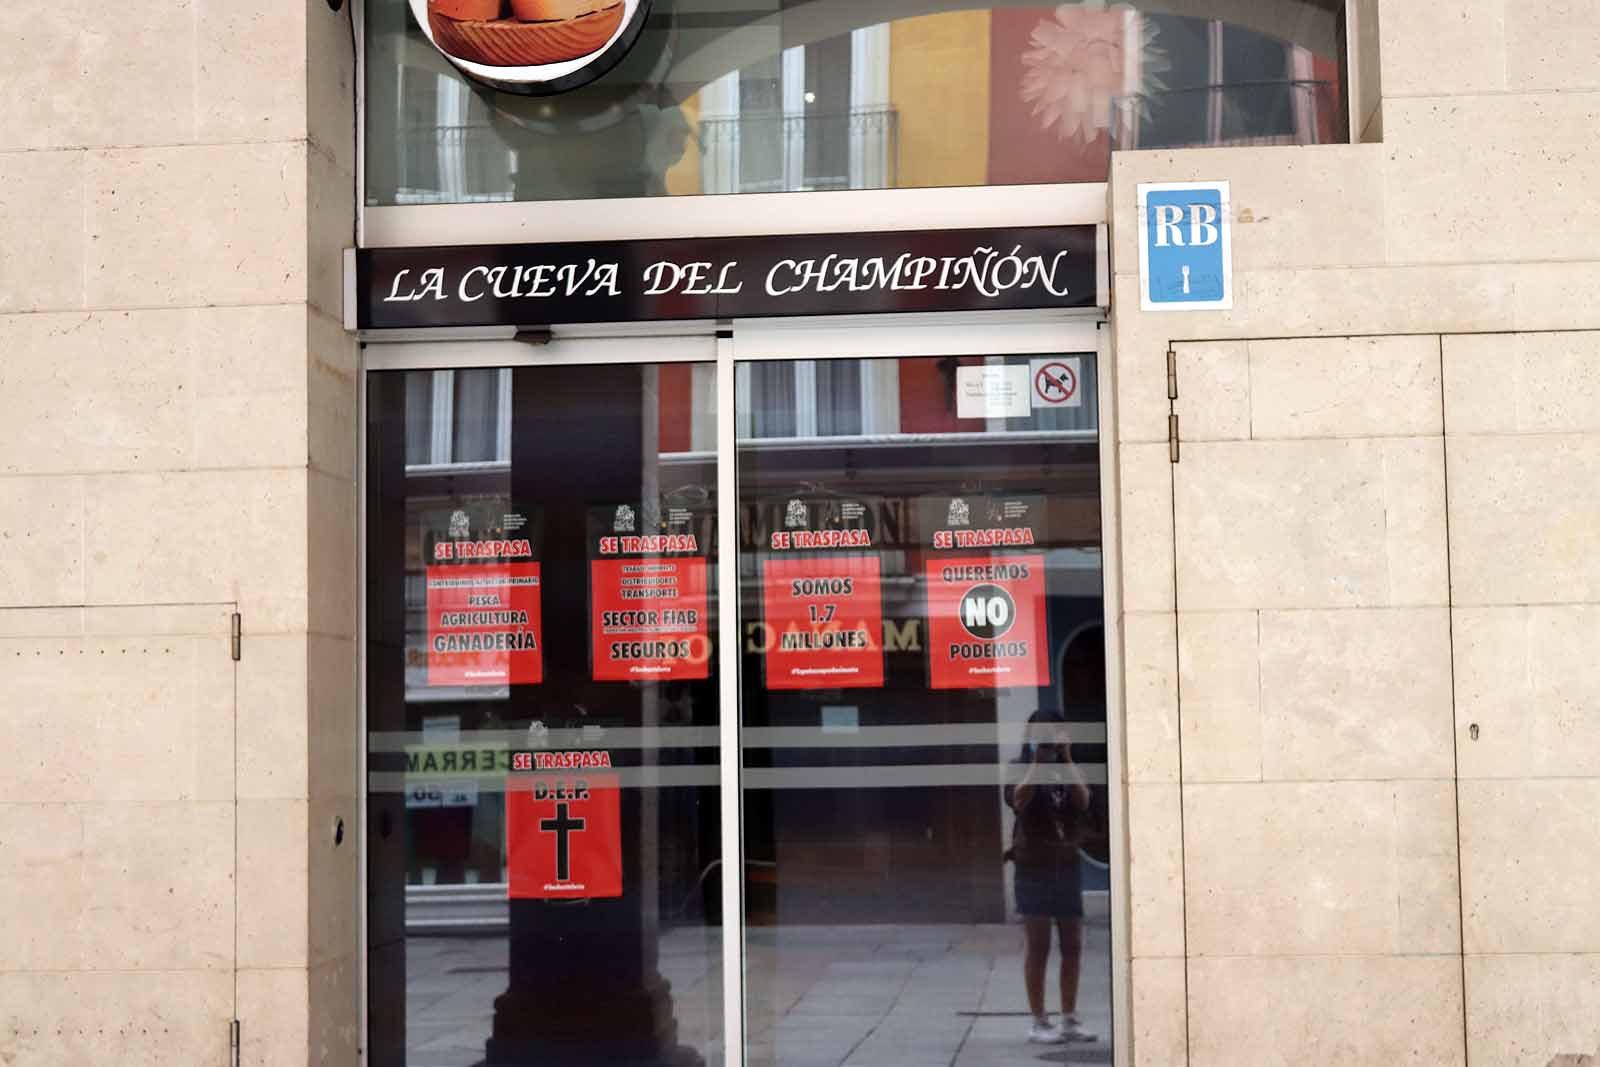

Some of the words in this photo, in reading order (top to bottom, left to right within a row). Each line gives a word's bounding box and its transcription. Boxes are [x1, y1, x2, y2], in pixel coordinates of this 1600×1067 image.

[1153, 204, 1218, 247] RB
[383, 266, 448, 303] LA
[458, 259, 622, 303] CUEVA
[642, 260, 743, 297] DEL
[763, 244, 1069, 298] CHAMPIÑÓN
[599, 536, 619, 555] SE
[621, 533, 698, 554] TRASPASA
[771, 531, 791, 550] SE
[794, 528, 871, 549] TRASPASA
[933, 531, 953, 549] SE
[955, 527, 1034, 547] TRASPASA
[434, 542, 454, 560] SE
[456, 538, 532, 559] TRASPASA
[942, 563, 1030, 583] QUEREMOS
[621, 588, 678, 600] TRANSPORTE
[792, 577, 854, 597] SOMOS
[468, 594, 501, 607] PESCA
[441, 610, 529, 627] AGRICULTURA
[602, 609, 658, 627] SECTOR
[662, 609, 698, 626] FIAB
[808, 604, 836, 625] 1.7
[964, 596, 1009, 628] NO
[434, 628, 537, 653] GANADERÍA
[611, 640, 691, 660] SEGUROS
[781, 630, 869, 650] MILLONES
[948, 640, 1030, 660] PODEMOS
[513, 752, 533, 770] SE
[535, 750, 613, 769] TRASPASA
[533, 780, 590, 801] D.E.P.
